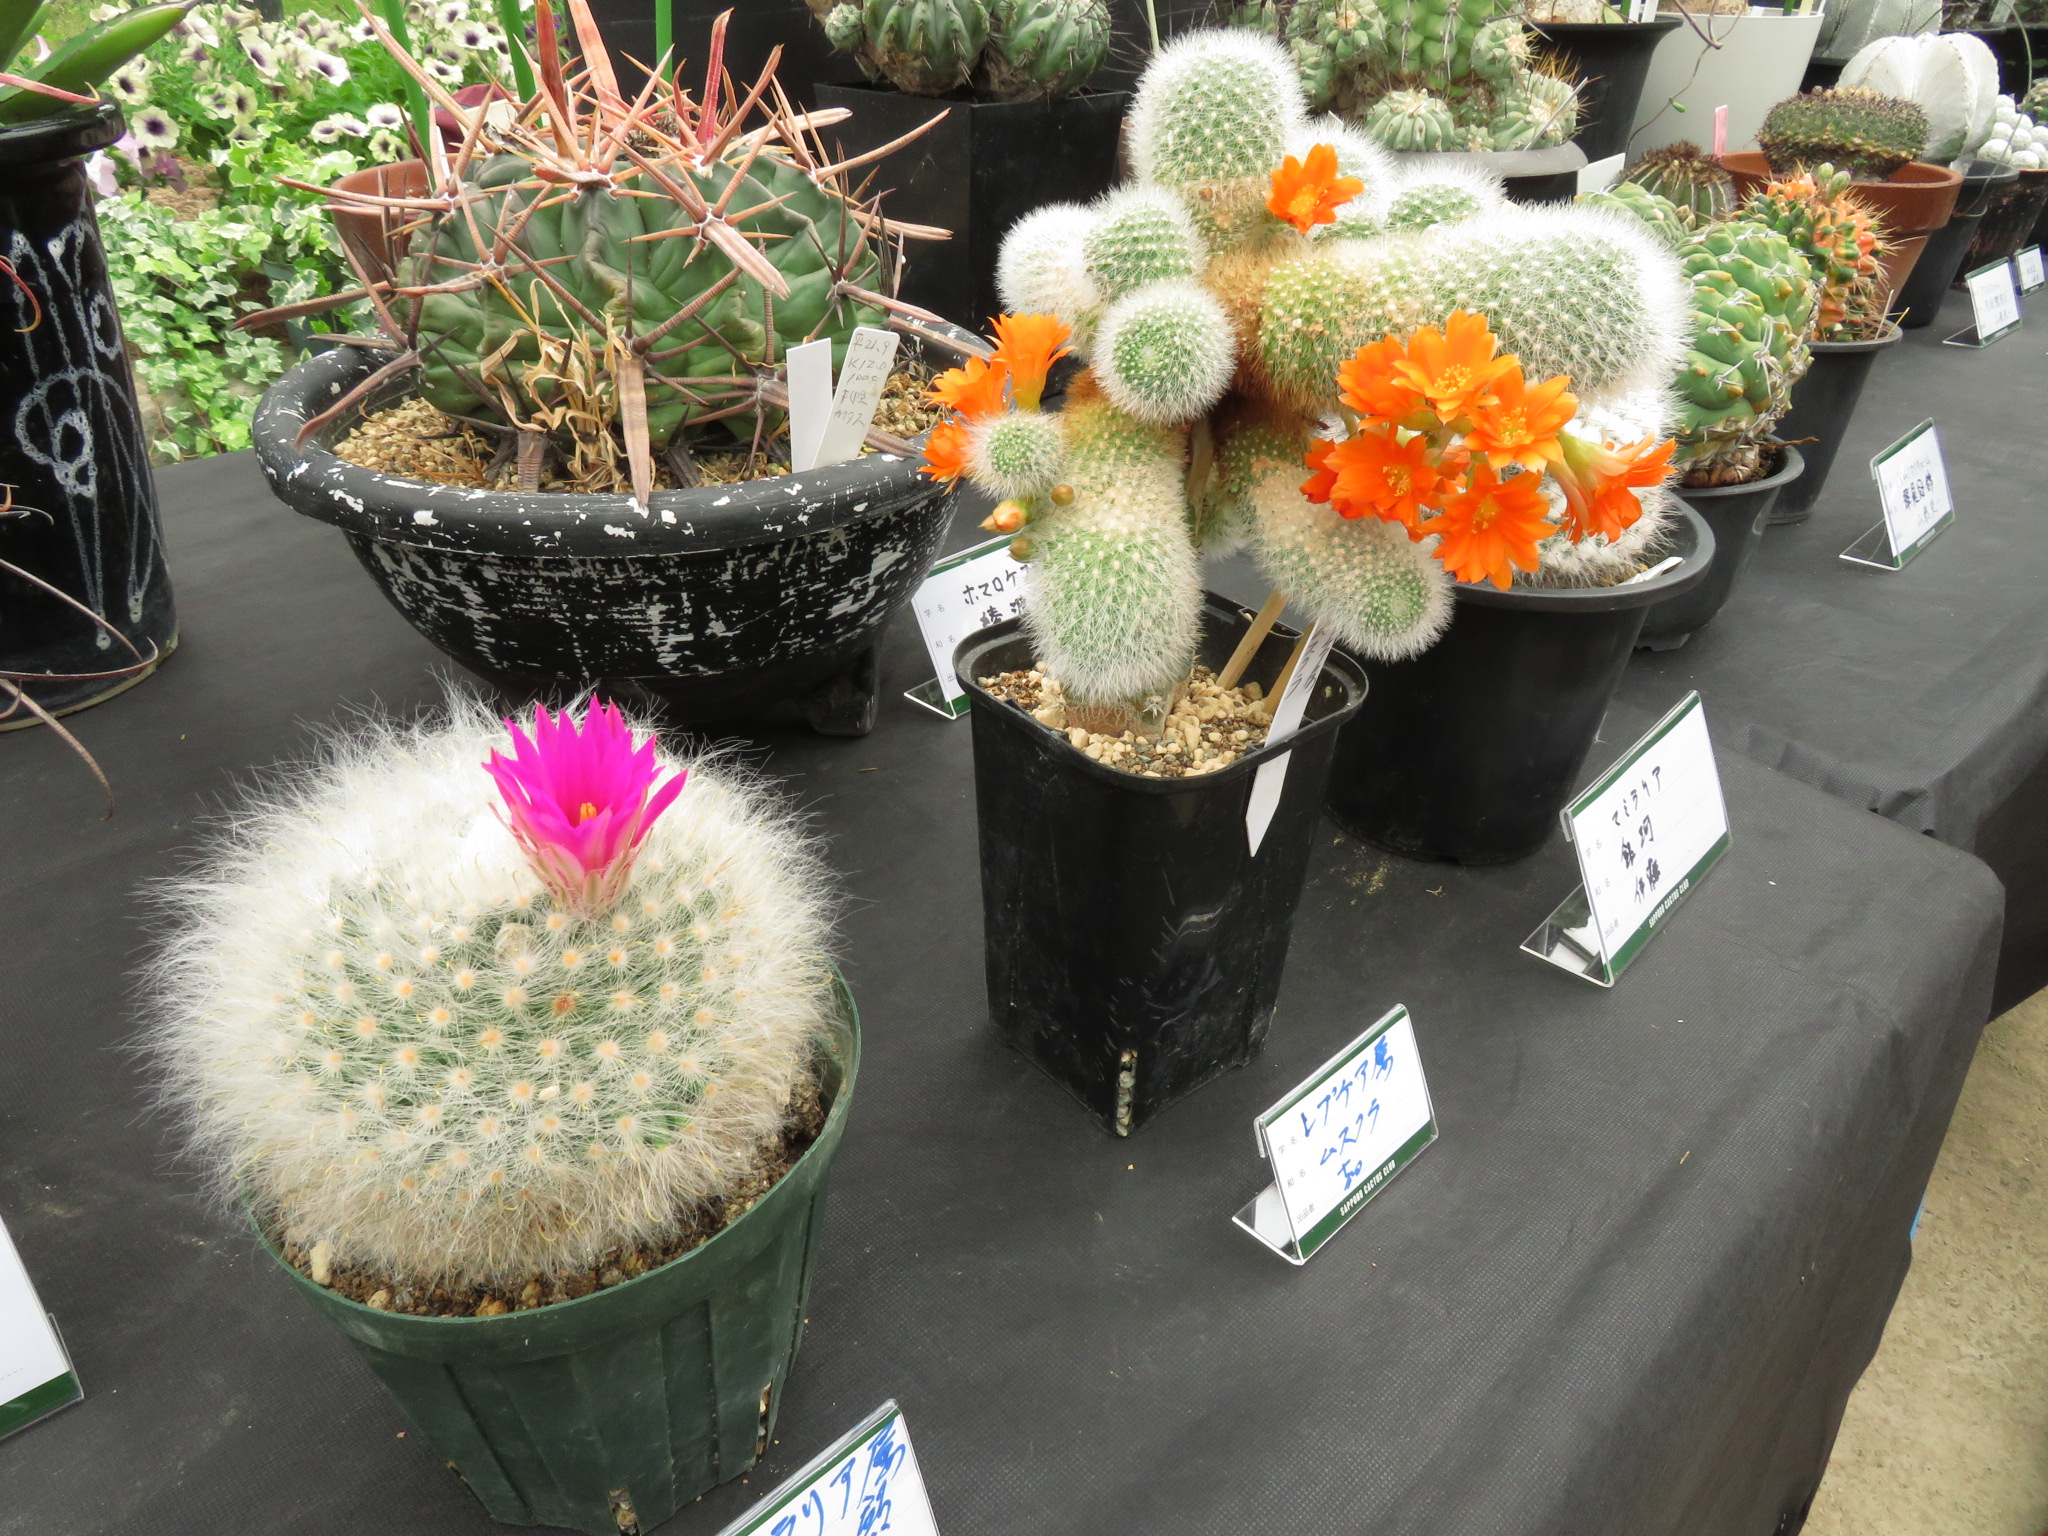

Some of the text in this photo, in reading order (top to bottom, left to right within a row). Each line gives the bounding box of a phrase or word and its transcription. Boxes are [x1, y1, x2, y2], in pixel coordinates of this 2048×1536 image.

[1664, 890, 1680, 912] CACTUS
[1678, 878, 1690, 897] CLUB
[1340, 1159, 1396, 1217] SAPPORO CACTUS CLUB
